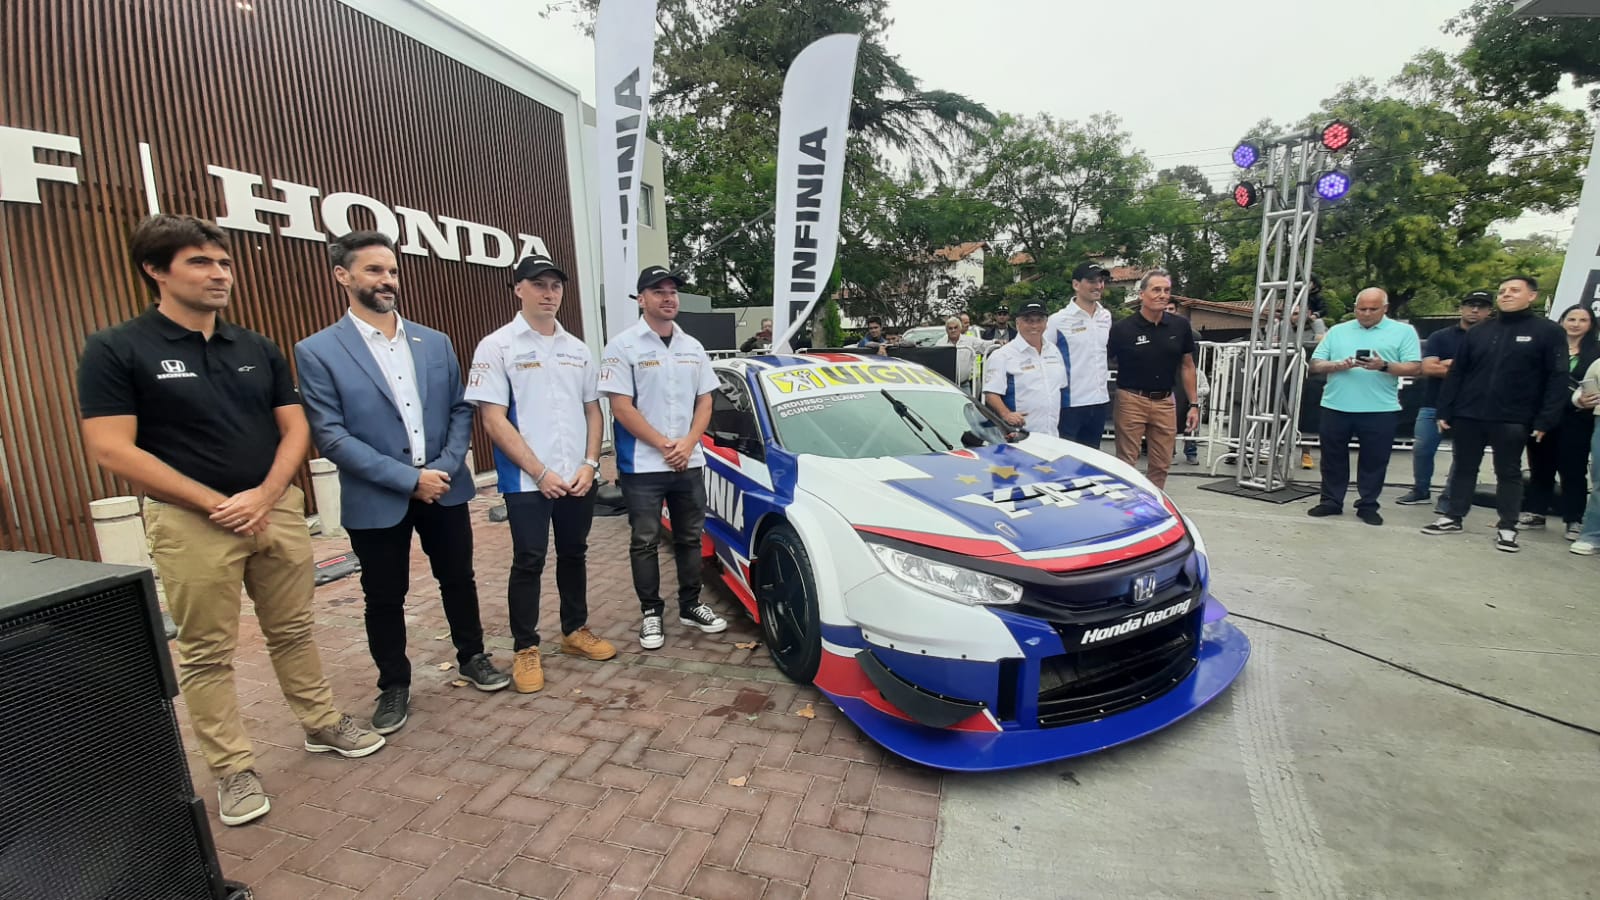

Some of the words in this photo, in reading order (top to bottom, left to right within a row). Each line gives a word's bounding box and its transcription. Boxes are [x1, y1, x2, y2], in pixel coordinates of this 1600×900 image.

[207, 164, 551, 270] HONDA
[790, 127, 828, 292] INFINIA
[776, 397, 823, 413] ARDUSSO
[779, 404, 824, 418] SCUNCIO
[1080, 617, 1142, 645] Honda
[1142, 599, 1192, 627] Racing
